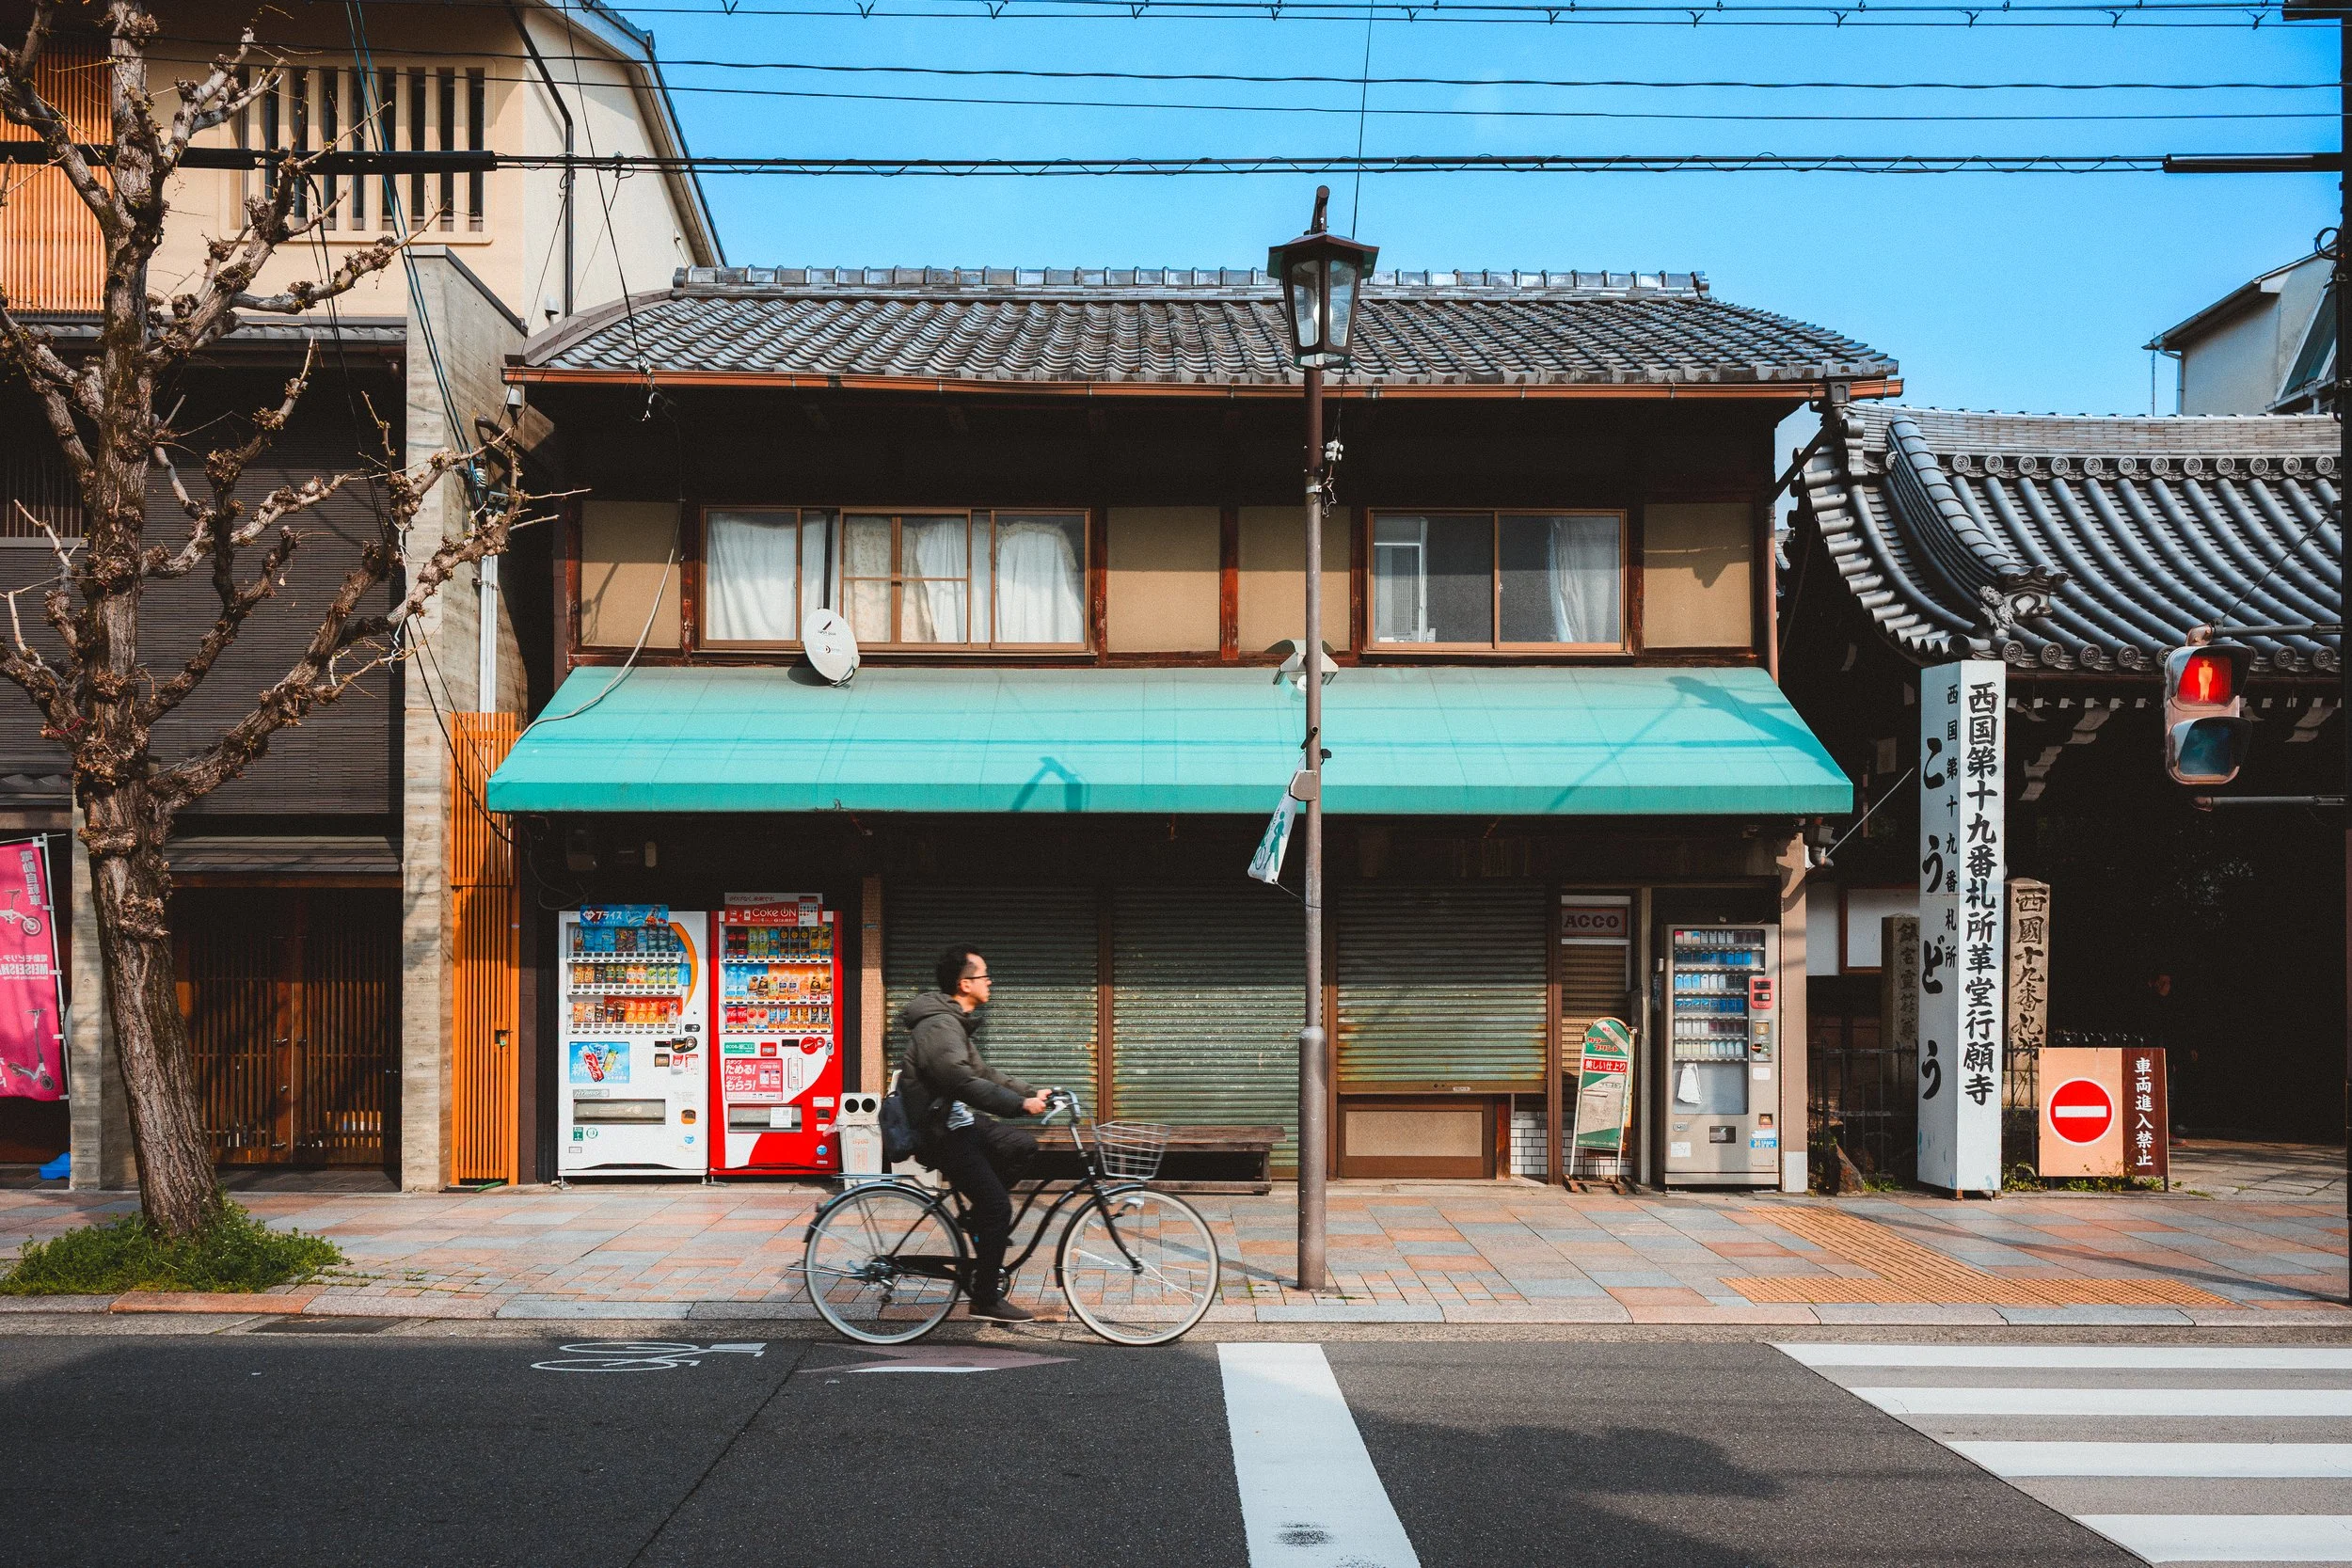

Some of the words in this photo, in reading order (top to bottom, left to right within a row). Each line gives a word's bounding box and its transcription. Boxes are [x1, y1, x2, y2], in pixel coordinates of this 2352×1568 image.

[1945, 683, 1959, 970] 西国第十九番札所
[752, 908, 778, 917] Coke
[780, 907, 797, 917] ON
[1921, 737, 1947, 1101] こうどう
[1963, 681, 1999, 1107] 西国第十九番札所革堂行願寺
[1584, 1060, 1627, 1072] 美しい仕上り
[1595, 1044, 1618, 1053] プリント
[2134, 1056, 2154, 1168] 車両進入禁止
